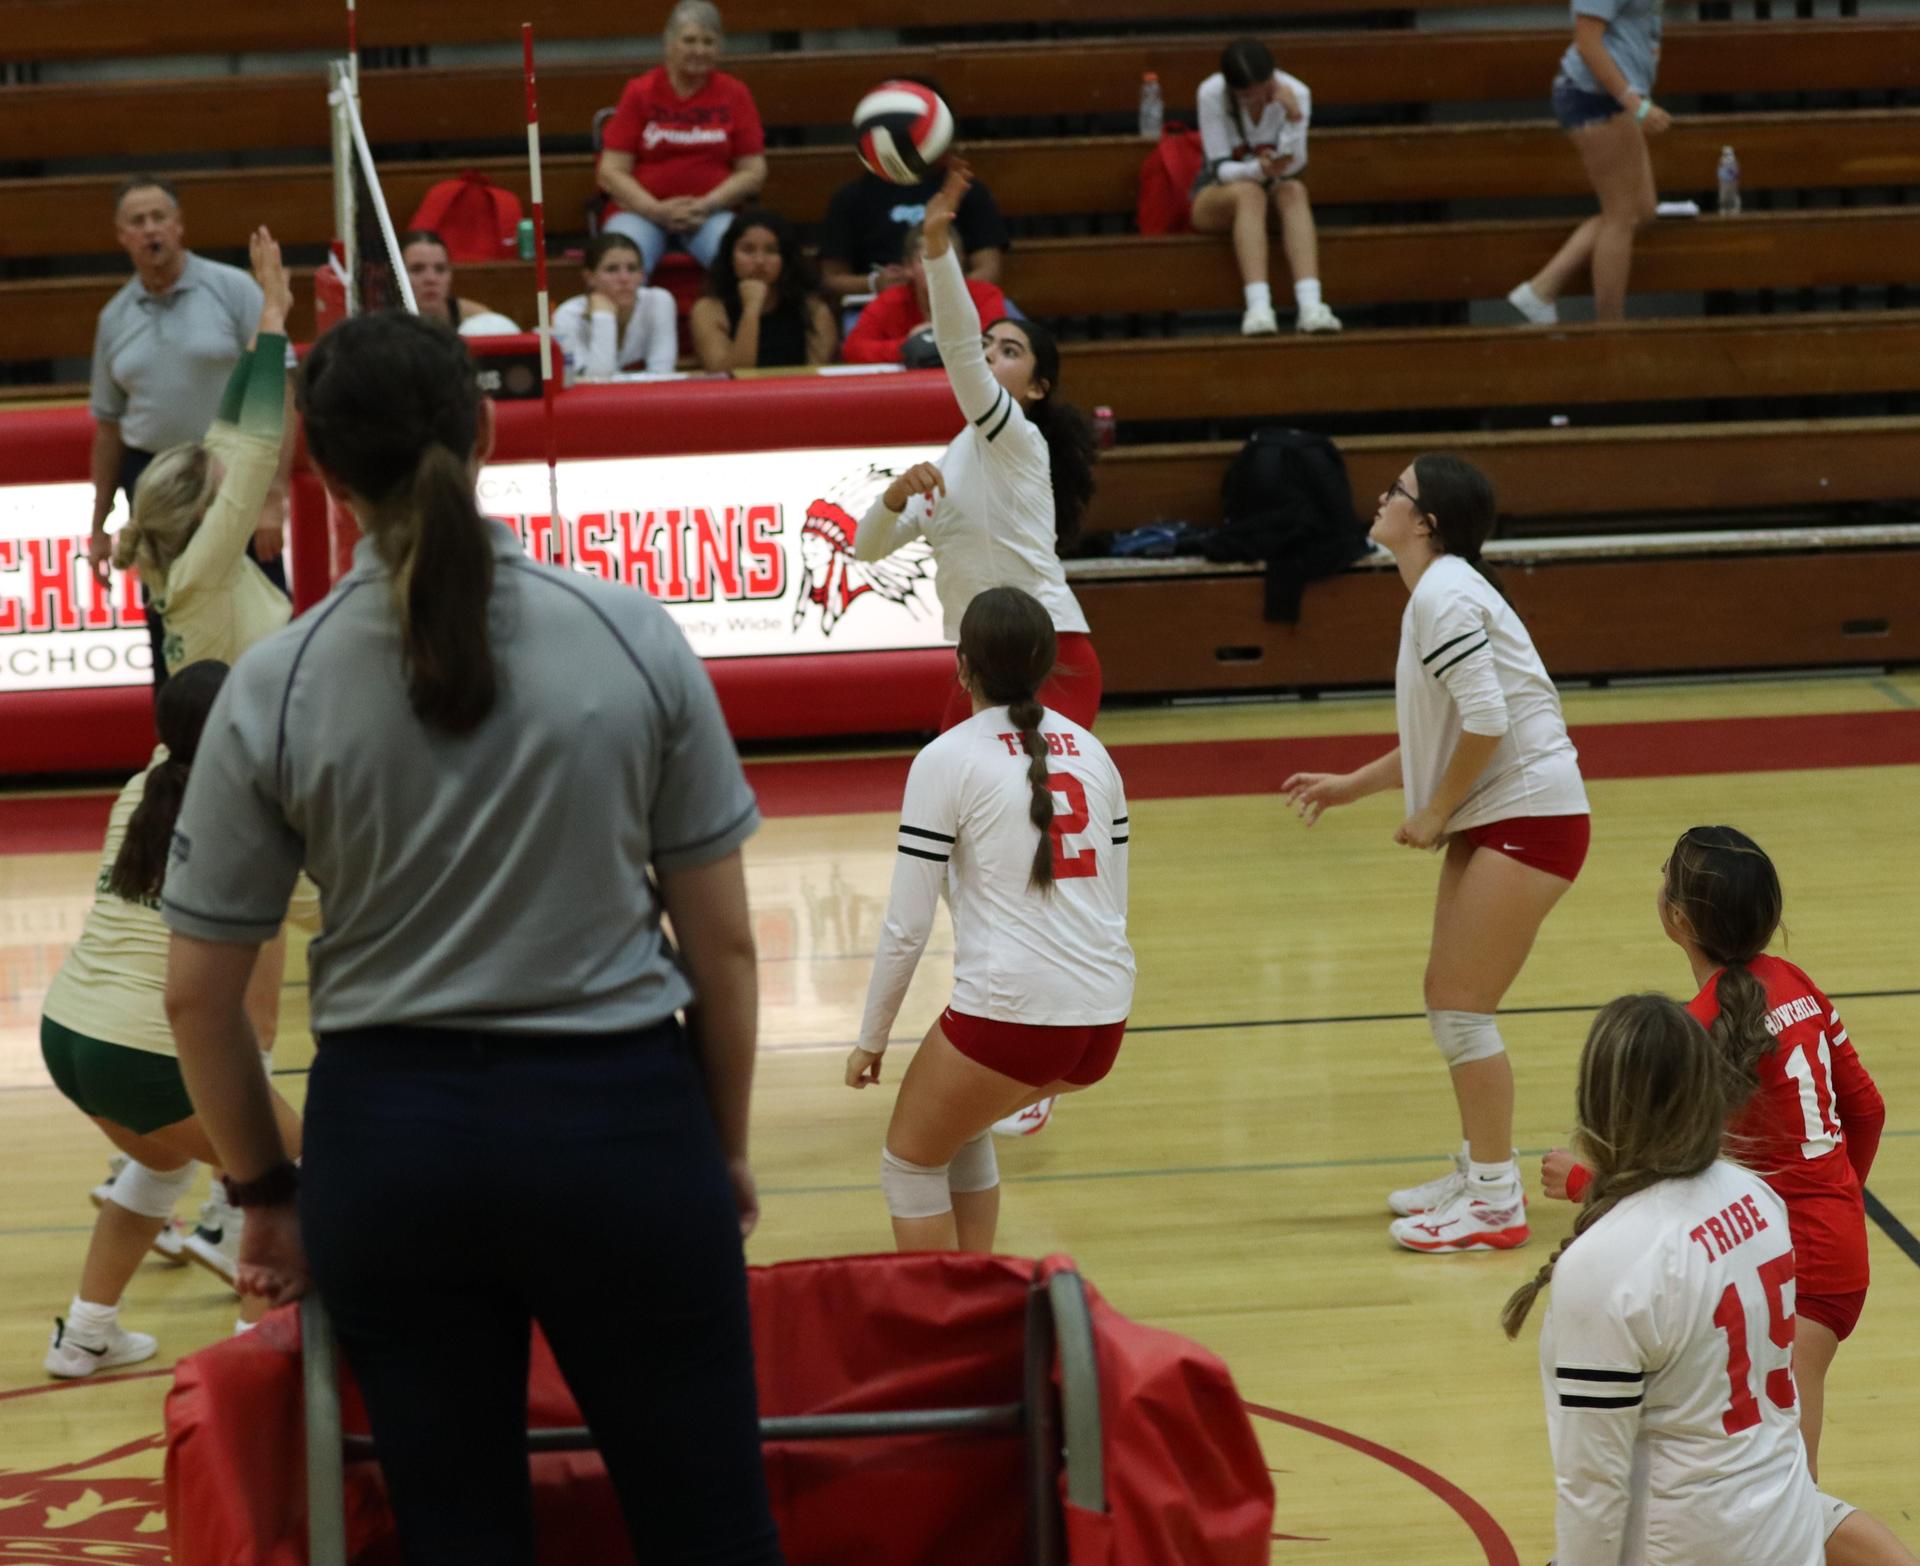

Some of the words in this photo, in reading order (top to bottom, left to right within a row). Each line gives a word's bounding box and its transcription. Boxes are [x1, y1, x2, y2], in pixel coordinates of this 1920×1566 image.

[484, 503, 784, 604] DSKINS
[997, 731, 1081, 757] TBE
[1046, 772, 1098, 880] 2
[1785, 1030, 1843, 1160] 11
[1689, 1193, 1769, 1264] TRIBE
[1713, 1247, 1797, 1437] 15
